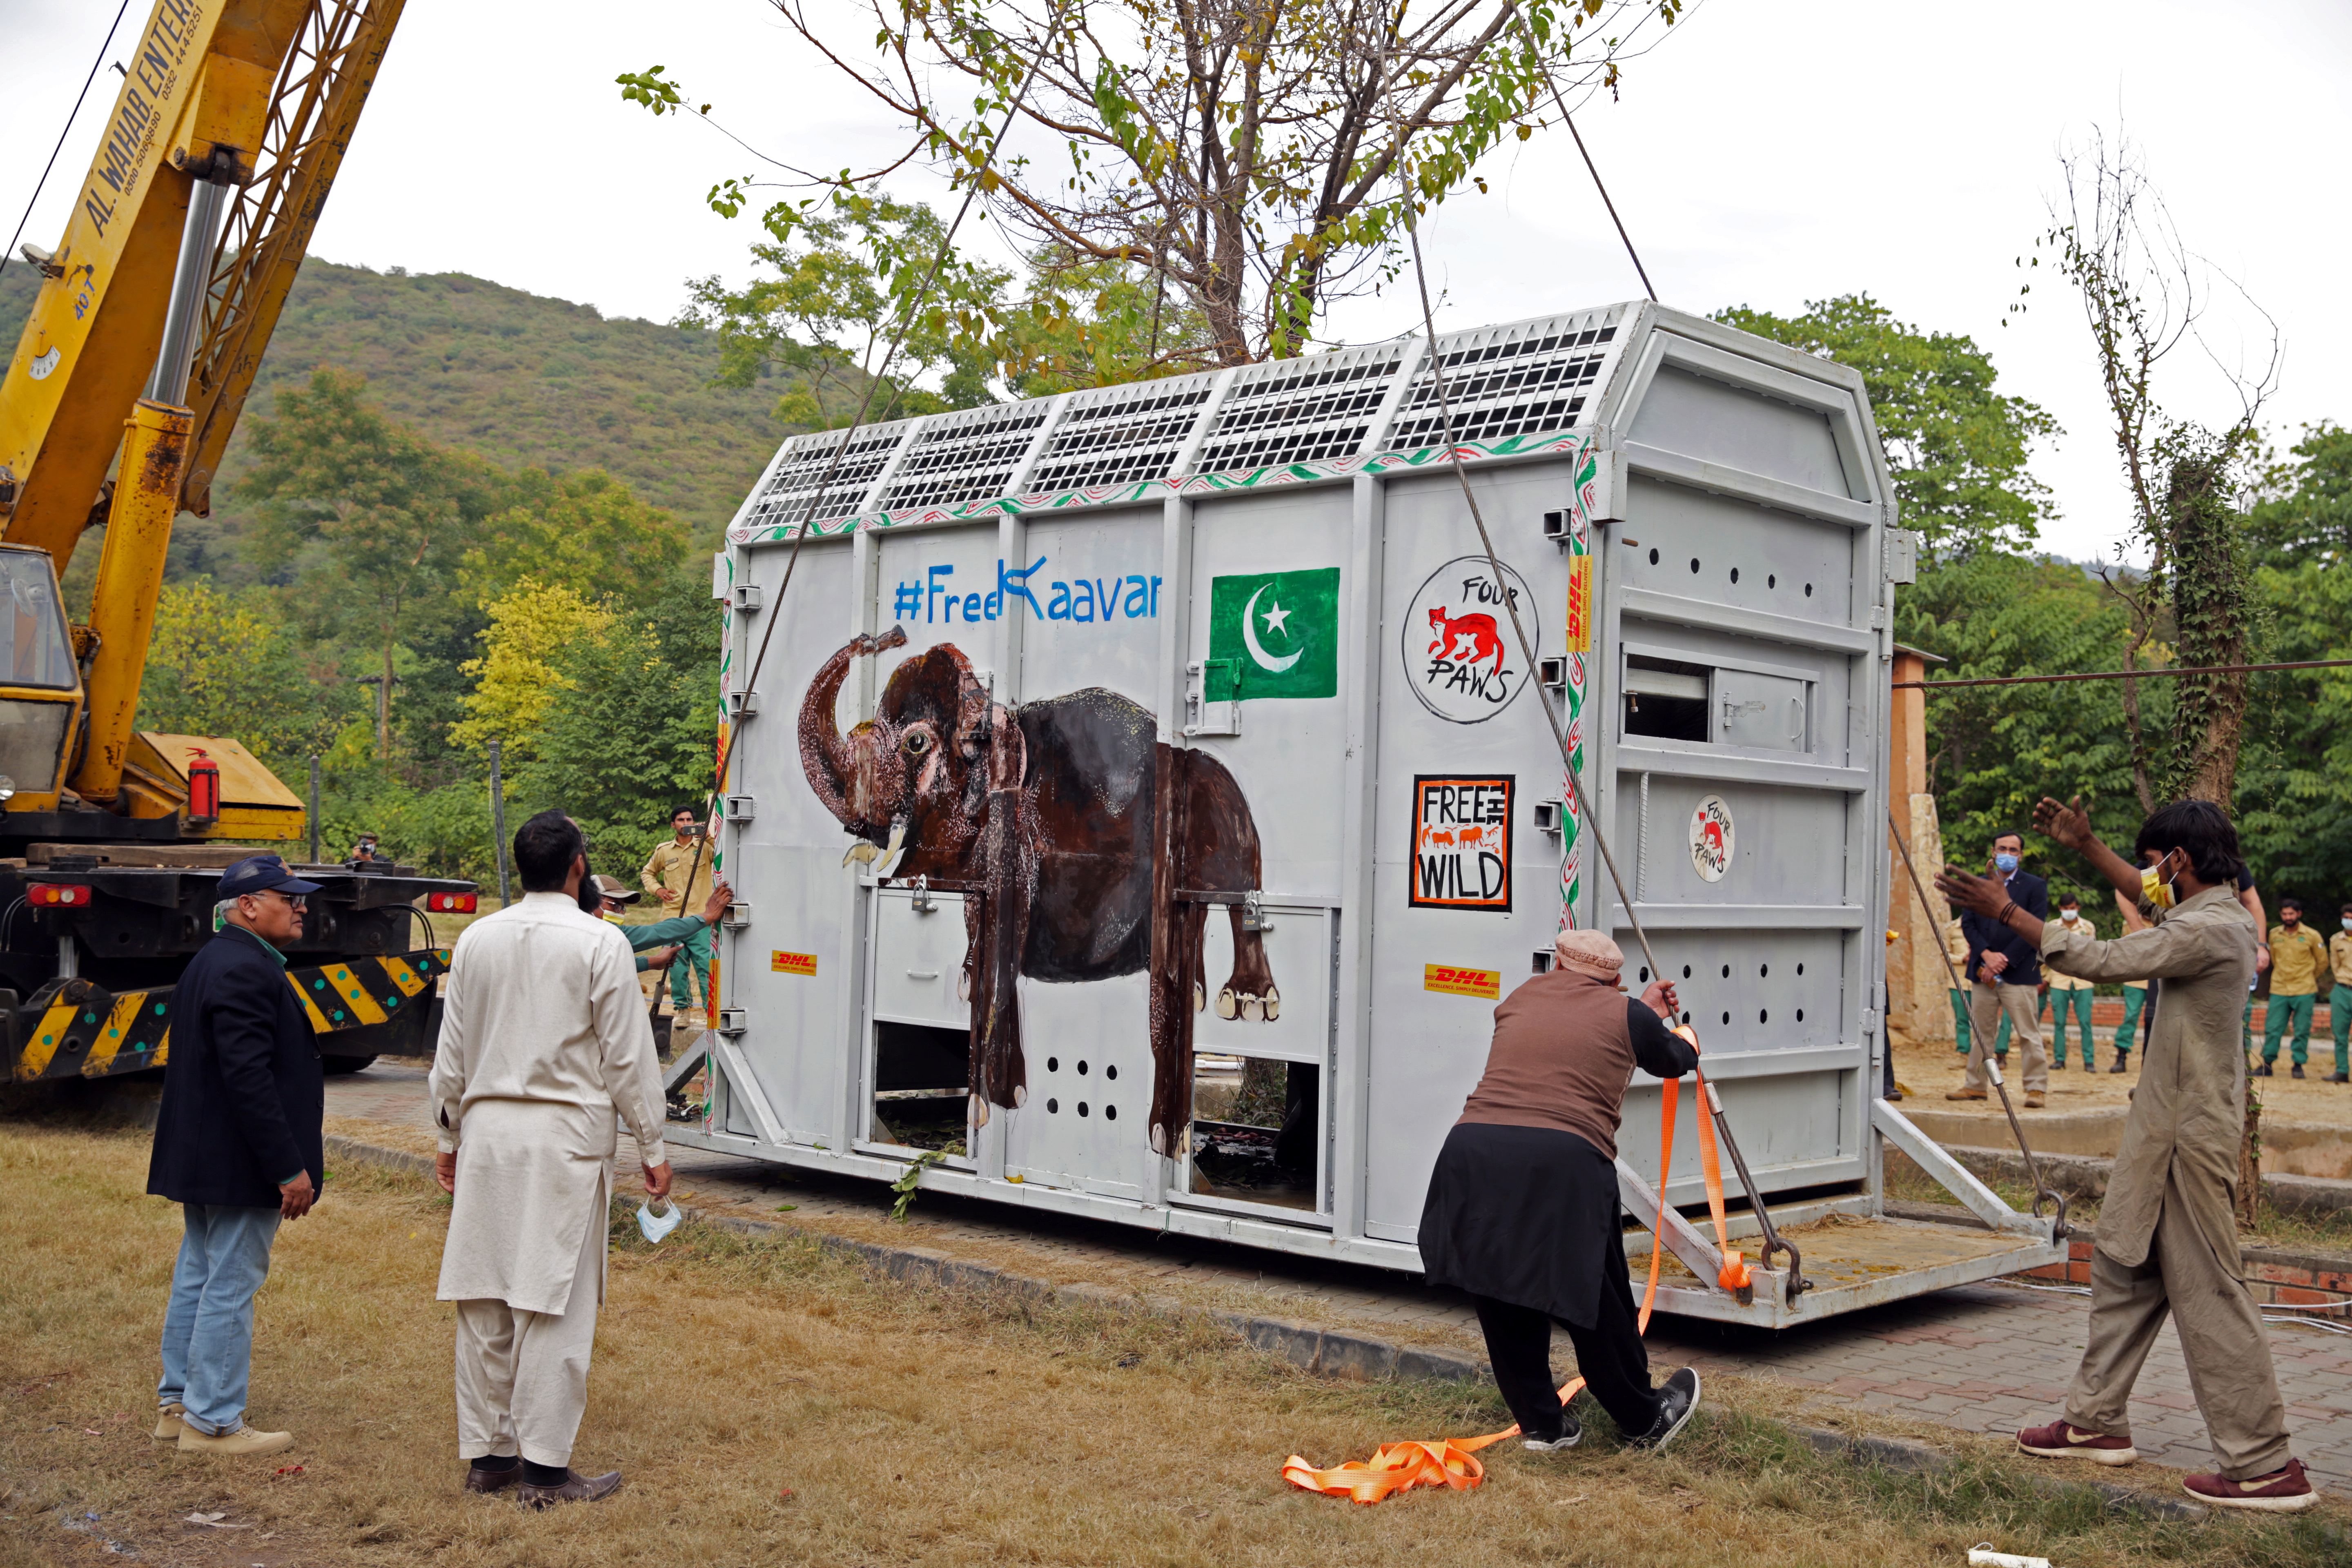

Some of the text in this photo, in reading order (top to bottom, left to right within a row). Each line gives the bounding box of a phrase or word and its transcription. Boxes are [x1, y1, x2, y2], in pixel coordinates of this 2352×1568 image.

[162, 70, 177, 100] 0332
[86, 0, 194, 239] AL. WAHAB. ENTER
[125, 168, 138, 196] 0300
[1462, 575, 1518, 612] FOUR
[1568, 568, 1582, 639] DHL
[1427, 659, 1514, 703] PAWS
[1423, 785, 1489, 824] FREE
[1486, 782, 1506, 825] THE
[1706, 801, 1731, 837] FOUR
[1417, 851, 1505, 899] WILD
[1695, 843, 1726, 873] PAWS
[778, 953, 811, 967] DHL
[1435, 968, 1490, 987] DHL
